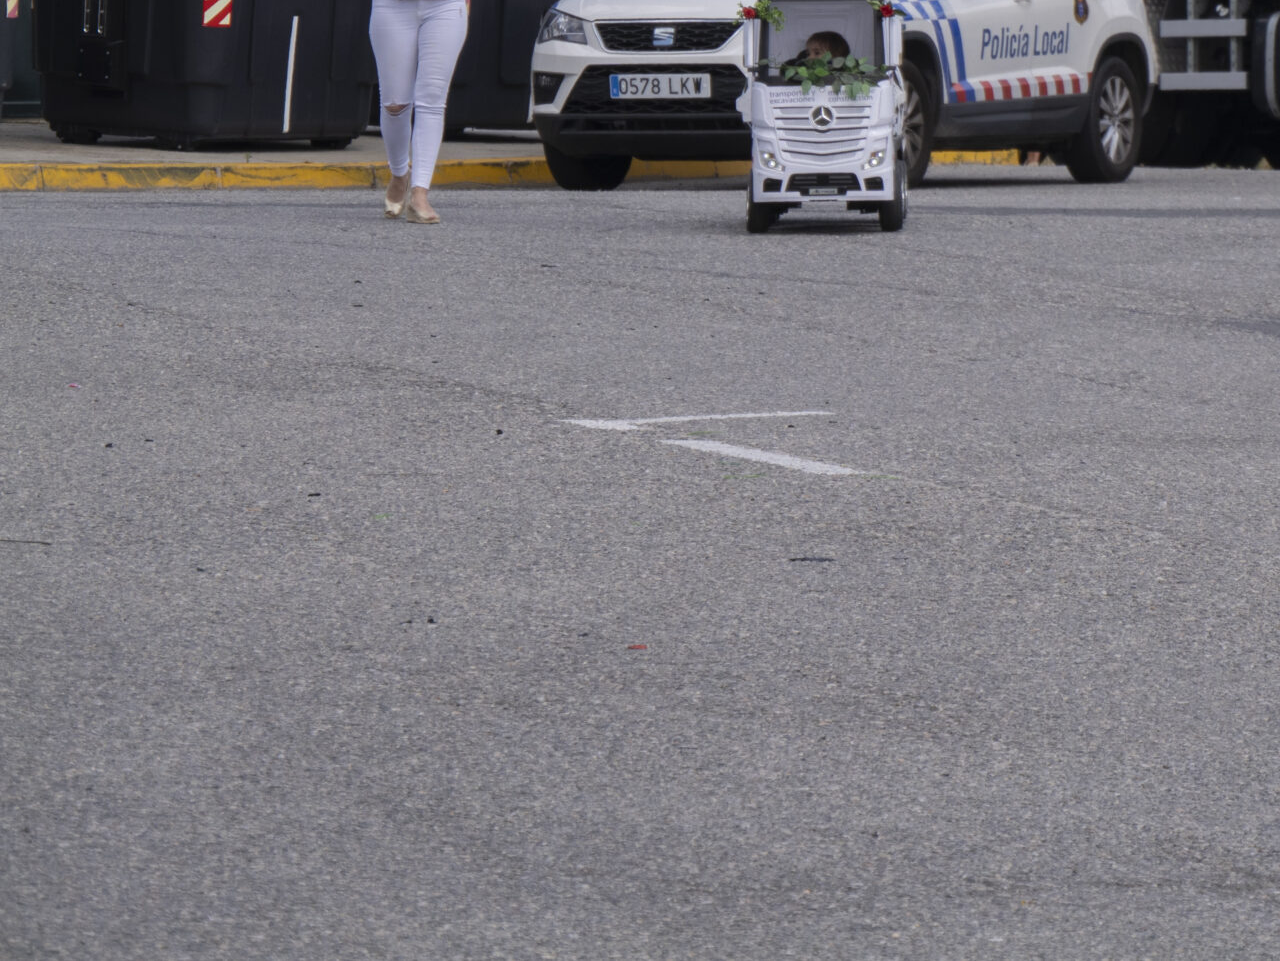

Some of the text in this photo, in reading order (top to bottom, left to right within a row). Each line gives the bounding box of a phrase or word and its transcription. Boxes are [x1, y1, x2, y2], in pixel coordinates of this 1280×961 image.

[980, 22, 1070, 60] Policía Local
[619, 77, 703, 96] 0578 LKW
